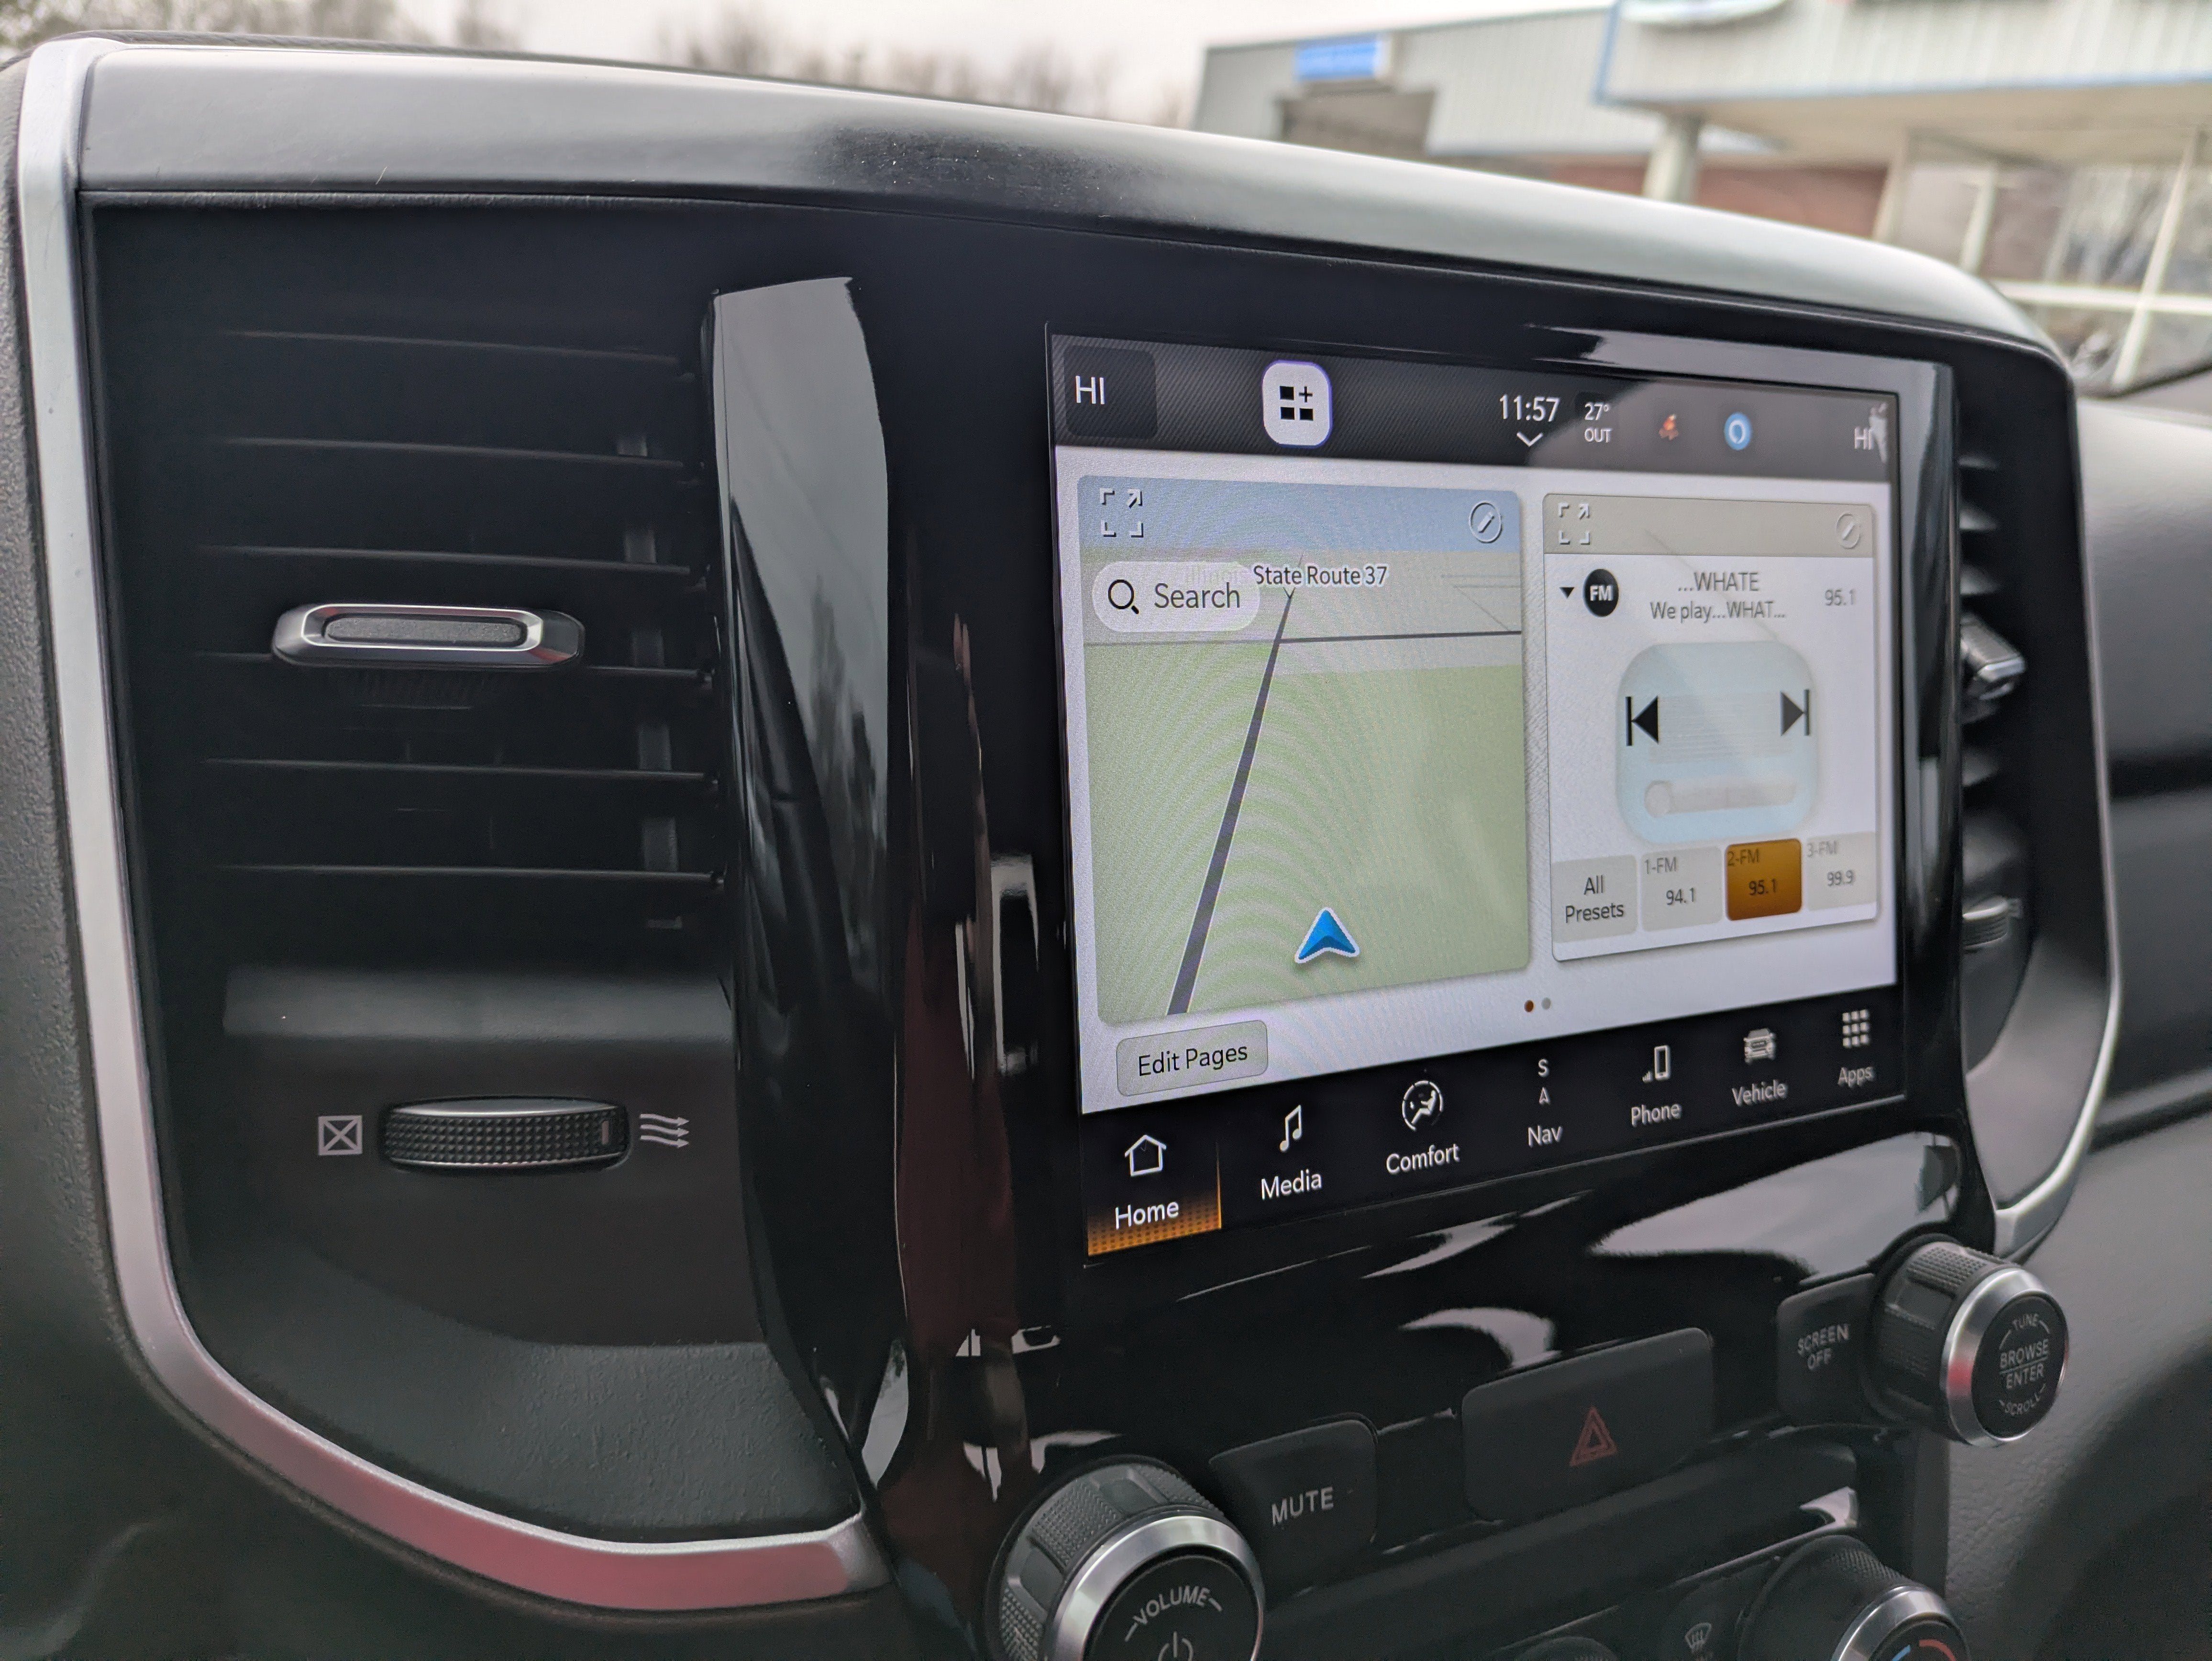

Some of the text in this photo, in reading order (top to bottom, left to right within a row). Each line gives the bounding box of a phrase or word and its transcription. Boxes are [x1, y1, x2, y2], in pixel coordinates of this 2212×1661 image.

[1075, 376, 1106, 405] HI
[1499, 394, 1560, 422] 11:57
[1584, 428, 1612, 443] OUT
[1253, 566, 1302, 586] State
[1307, 566, 1360, 586] Route
[1365, 566, 1387, 585] 37
[1154, 583, 1241, 609] Search
[1590, 586, 1613, 602] FM
[1824, 589, 1856, 607] 95.1
[1650, 601, 1677, 620] We
[1727, 849, 1760, 867] 2-FM
[1807, 841, 1838, 858] 3-FM
[1645, 857, 1677, 875] 1-FM
[1583, 875, 1604, 896] All
[1748, 878, 1778, 896] 95.1
[1826, 870, 1855, 887] 99.9
[1666, 887, 1696, 906] 94.1
[1565, 902, 1625, 923] Presets
[1139, 1044, 1248, 1076] Edit Pages
[1838, 1066, 1874, 1087] Apps
[1732, 1080, 1789, 1107] Vehicle
[1631, 1103, 1681, 1126] Phone
[1528, 1126, 1563, 1147] Nav
[1386, 1143, 1460, 1175] Comfort
[1261, 1169, 1323, 1200] Media
[1115, 1200, 1179, 1230] Home
[2012, 1314, 2039, 1331] TUNE
[1798, 1323, 1848, 1356] SCREEN
[1807, 1348, 1832, 1370] OFF
[2000, 1339, 2049, 1369] BROWSE
[2006, 1363, 2044, 1389] ENTER
[2004, 1393, 2041, 1415] SCROLL
[1271, 1486, 1335, 1526] MUTE
[1132, 1585, 1210, 1628] VOLUME
